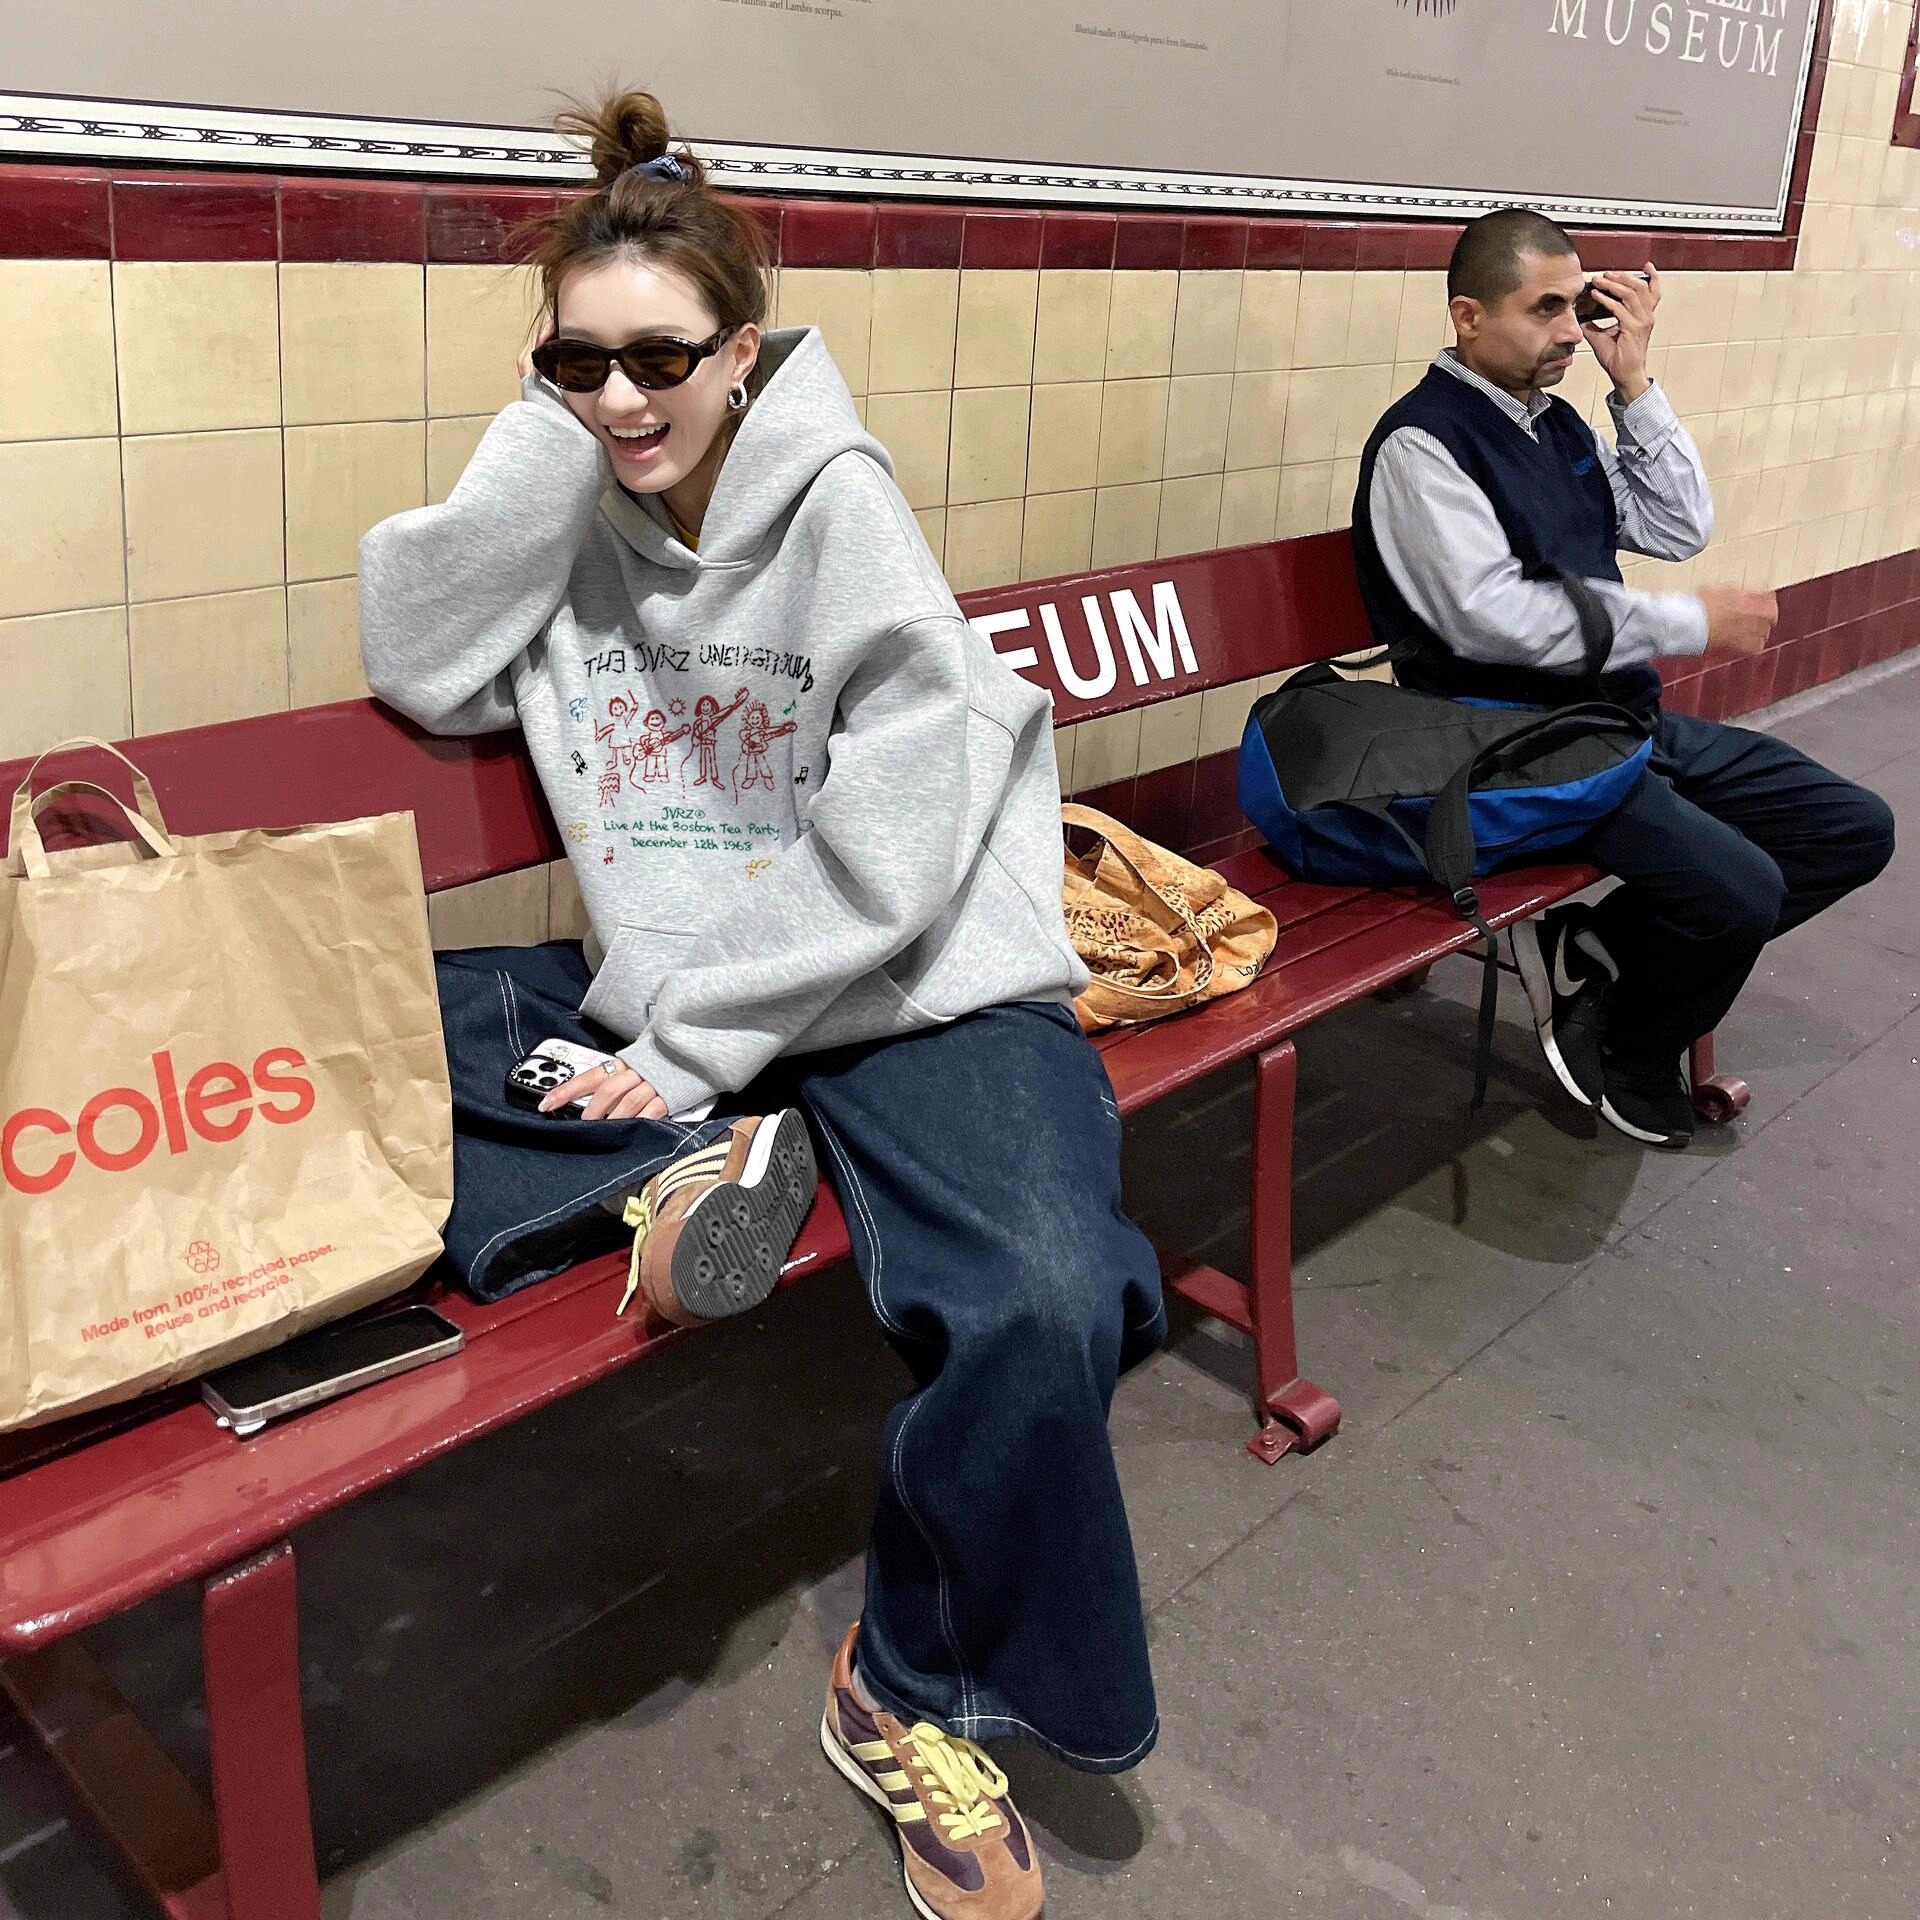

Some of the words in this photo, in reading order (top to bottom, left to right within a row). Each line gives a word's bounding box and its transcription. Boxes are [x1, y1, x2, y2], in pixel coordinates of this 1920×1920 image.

[1548, 0, 1784, 77] MUSEUM
[584, 650, 625, 677] THE
[634, 642, 690, 673] JVRZ
[603, 820, 629, 831] Live
[632, 821, 645, 830] At
[650, 821, 669, 832] the
[672, 821, 716, 833] Boston
[720, 823, 742, 834] Tea
[747, 823, 780, 841] Party
[631, 836, 688, 849] December
[694, 839, 719, 850] 12th
[723, 840, 753, 851] 1968
[1, 1047, 315, 1194] coles
[80, 1317, 130, 1343] Made
[133, 1302, 171, 1324] from
[174, 1281, 219, 1309] 100%
[221, 1258, 287, 1292] recycled
[289, 1243, 338, 1268] paper.
[144, 1312, 194, 1339] Reuse
[198, 1296, 231, 1318] and
[233, 1274, 294, 1306] recycle.
